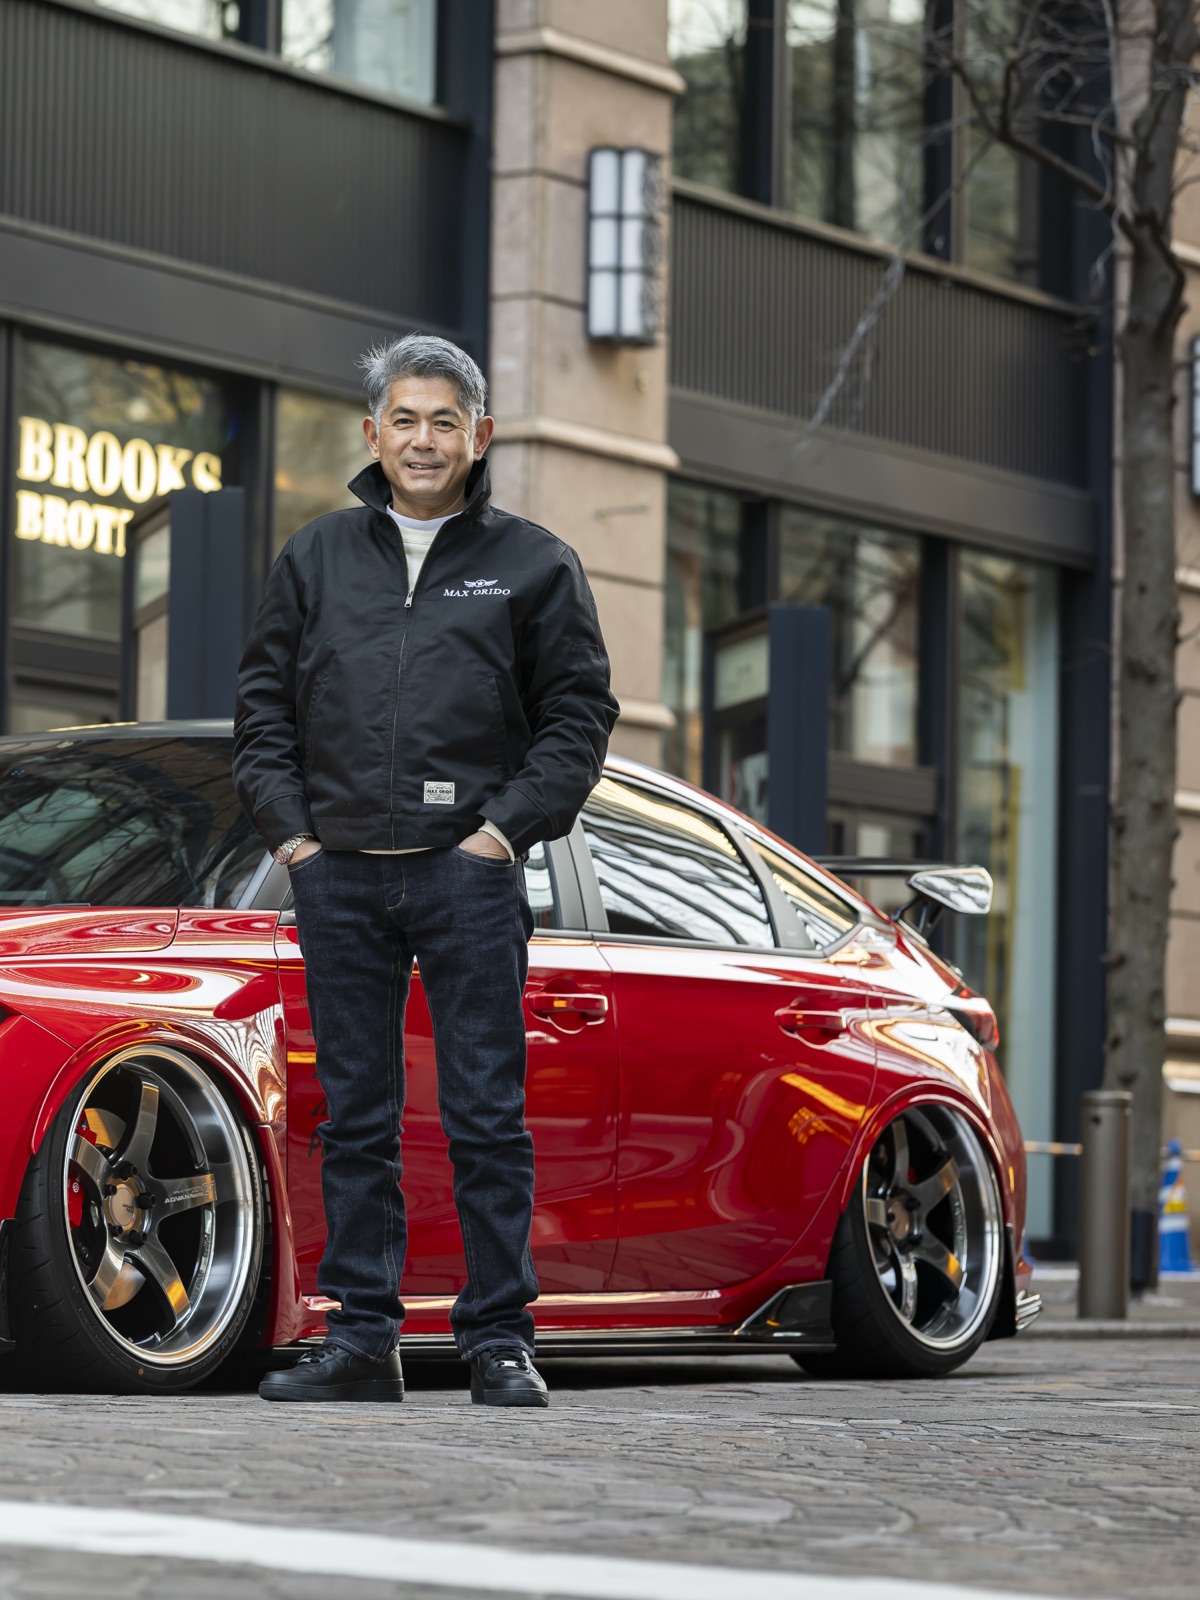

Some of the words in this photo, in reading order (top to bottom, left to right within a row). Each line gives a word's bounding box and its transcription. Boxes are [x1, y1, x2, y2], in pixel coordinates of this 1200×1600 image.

[16, 415, 222, 504] BROOKS
[443, 588, 470, 597] MAX
[473, 588, 511, 596] ORIDO
[164, 1194, 191, 1204] ADVAN
